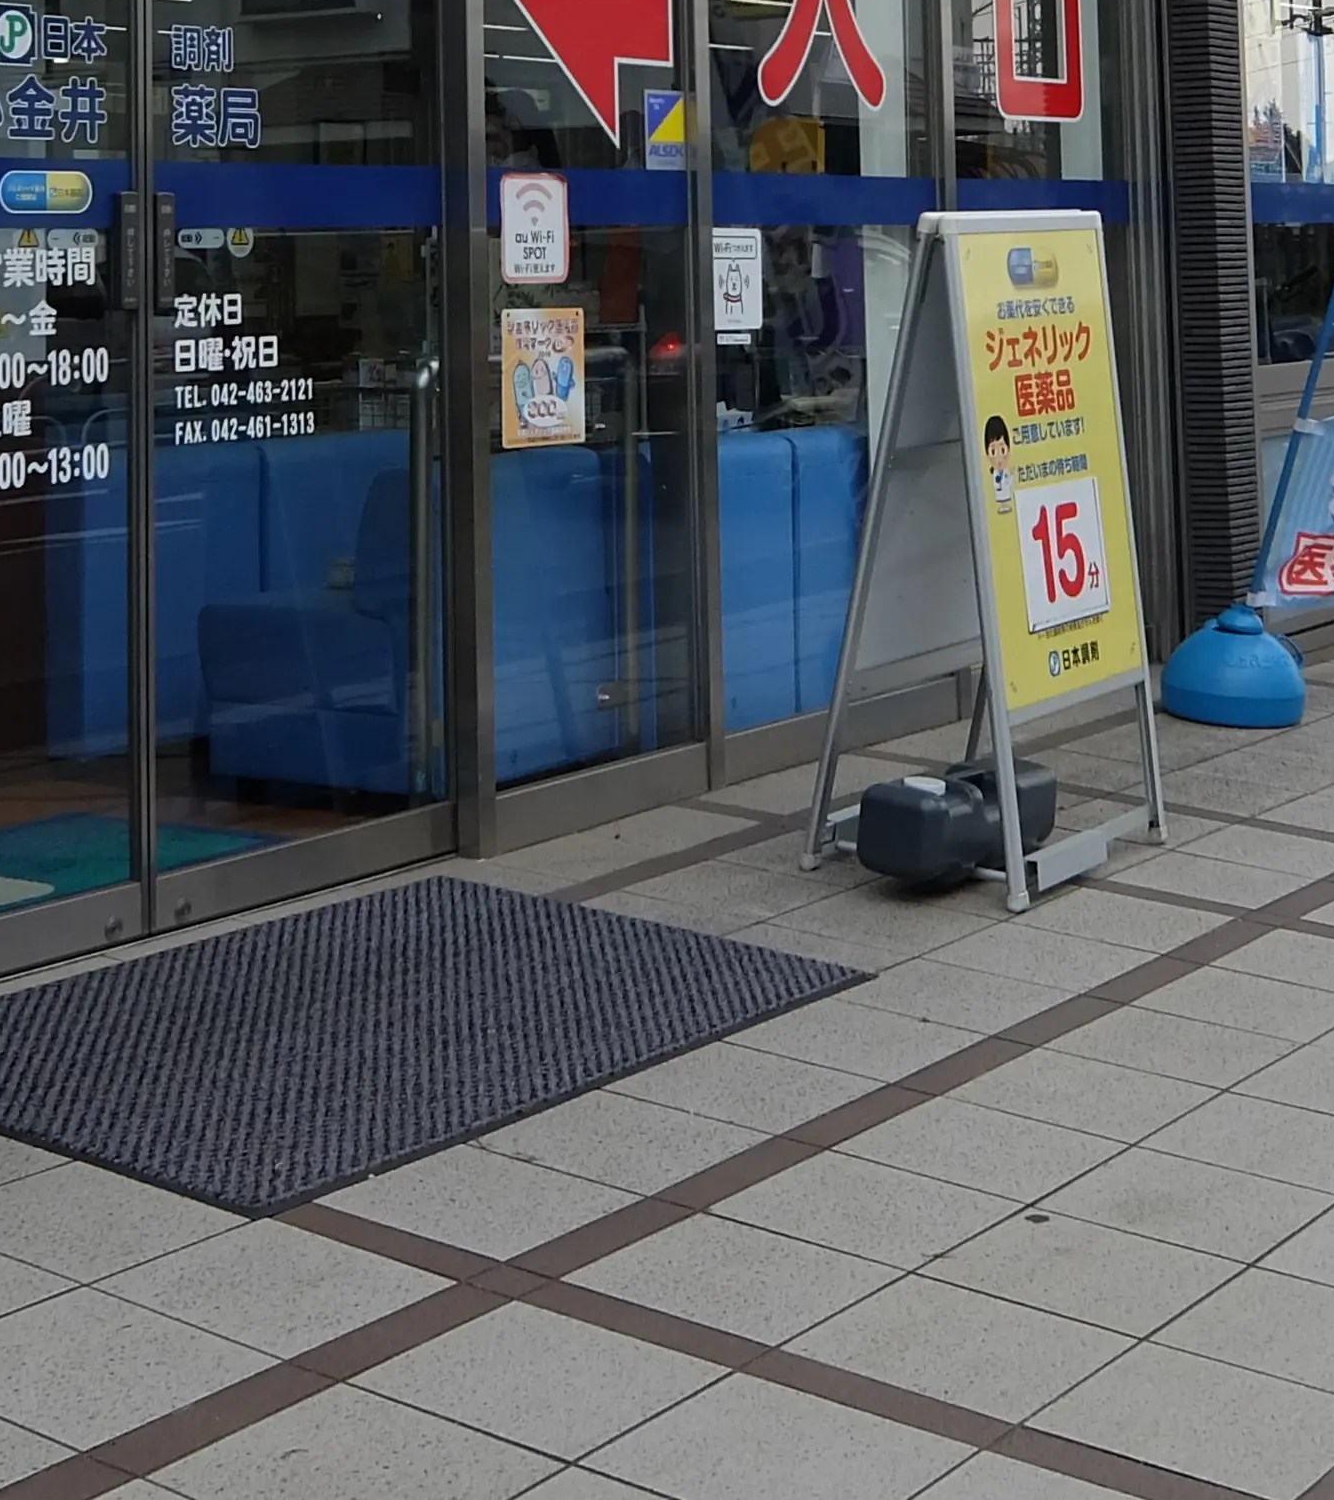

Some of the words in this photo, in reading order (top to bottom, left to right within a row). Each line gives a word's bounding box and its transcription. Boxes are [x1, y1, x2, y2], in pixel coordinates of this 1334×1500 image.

[41, 15, 107, 63] 日本
[171, 25, 234, 72] 調剤
[171, 82, 262, 148] 薬局
[515, 233, 528, 243] au
[531, 230, 554, 243] Wi-Fi
[523, 246, 547, 260] SPOT
[173, 293, 243, 329] 定休日
[985, 320, 1091, 371] ジェネリック
[211, 377, 314, 406] 042-463-2121
[1014, 369, 1075, 416] 医薬品
[211, 411, 315, 442] 042-461-1313
[1032, 502, 1088, 603] 15
[1088, 561, 1100, 589] 分
